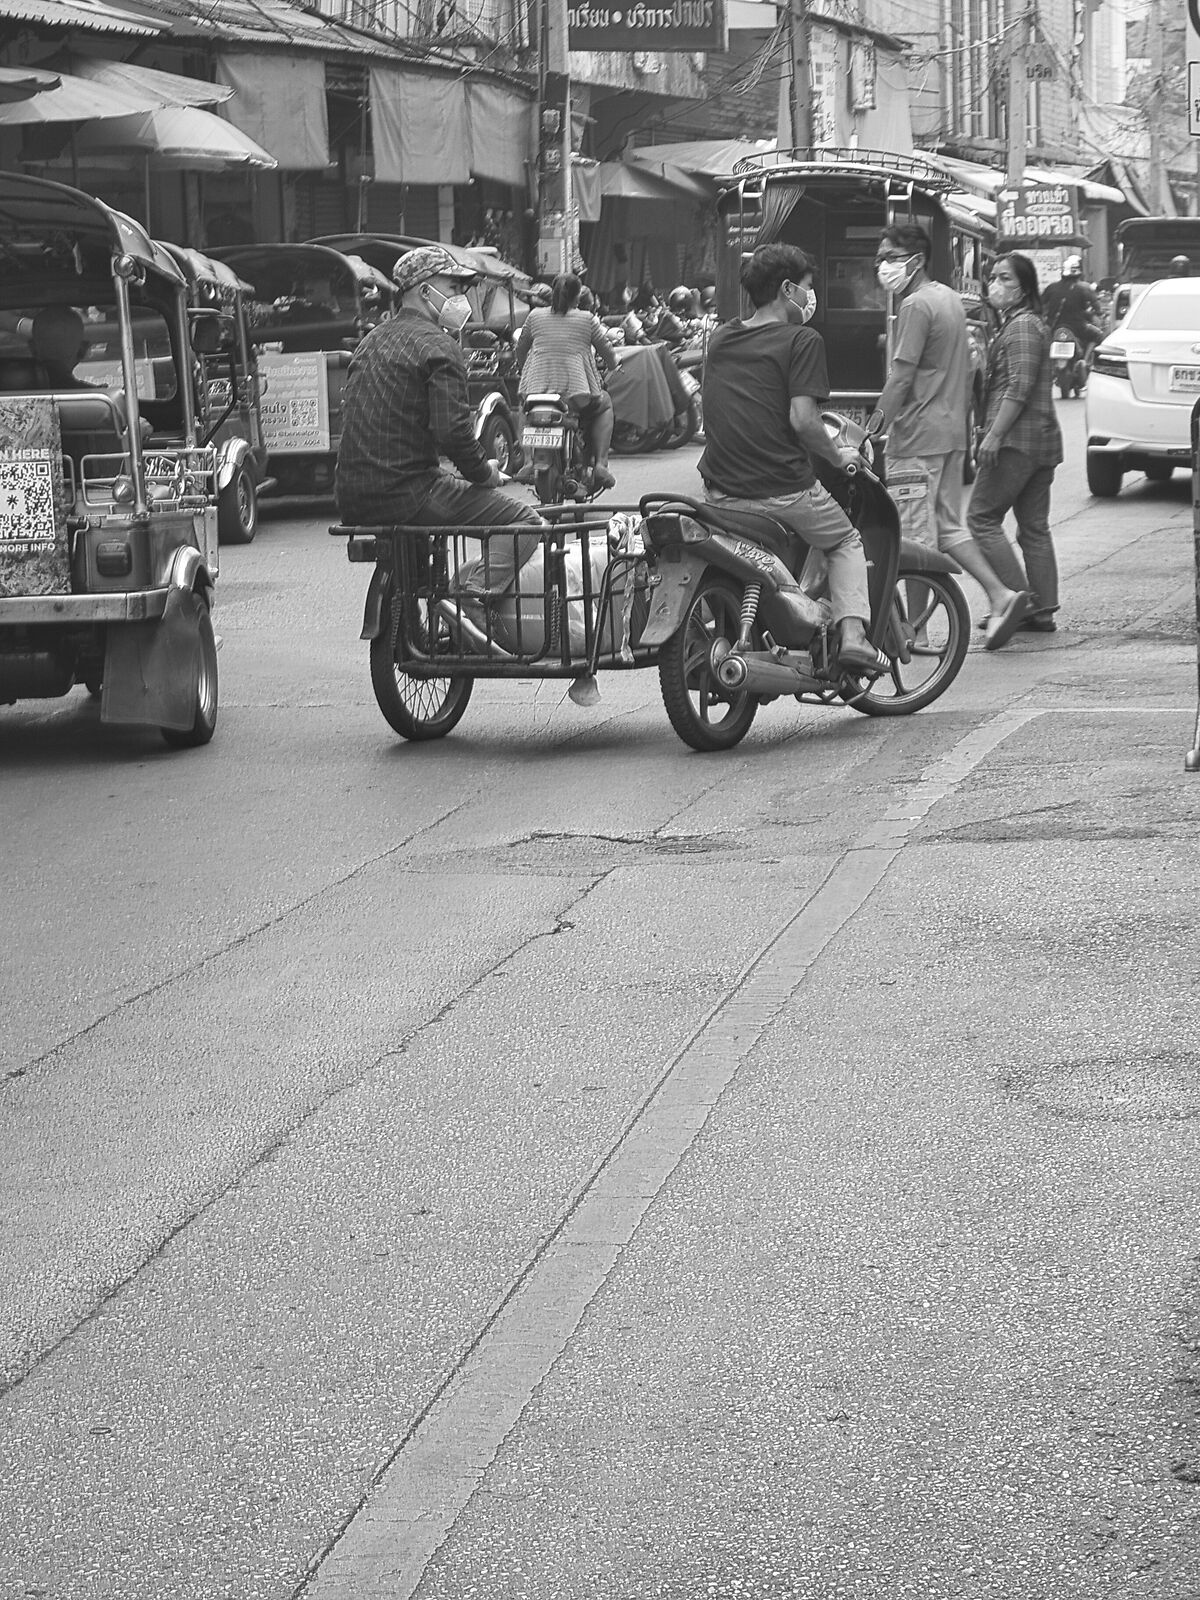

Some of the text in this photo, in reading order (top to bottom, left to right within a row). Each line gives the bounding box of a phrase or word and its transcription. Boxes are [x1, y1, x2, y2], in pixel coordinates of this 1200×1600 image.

[1024, 184, 1069, 204] ทางเข้า
[1001, 201, 1074, 236] ที่จอดรถ
[12, 449, 50, 460] HERE
[31, 543, 56, 551] INFO
